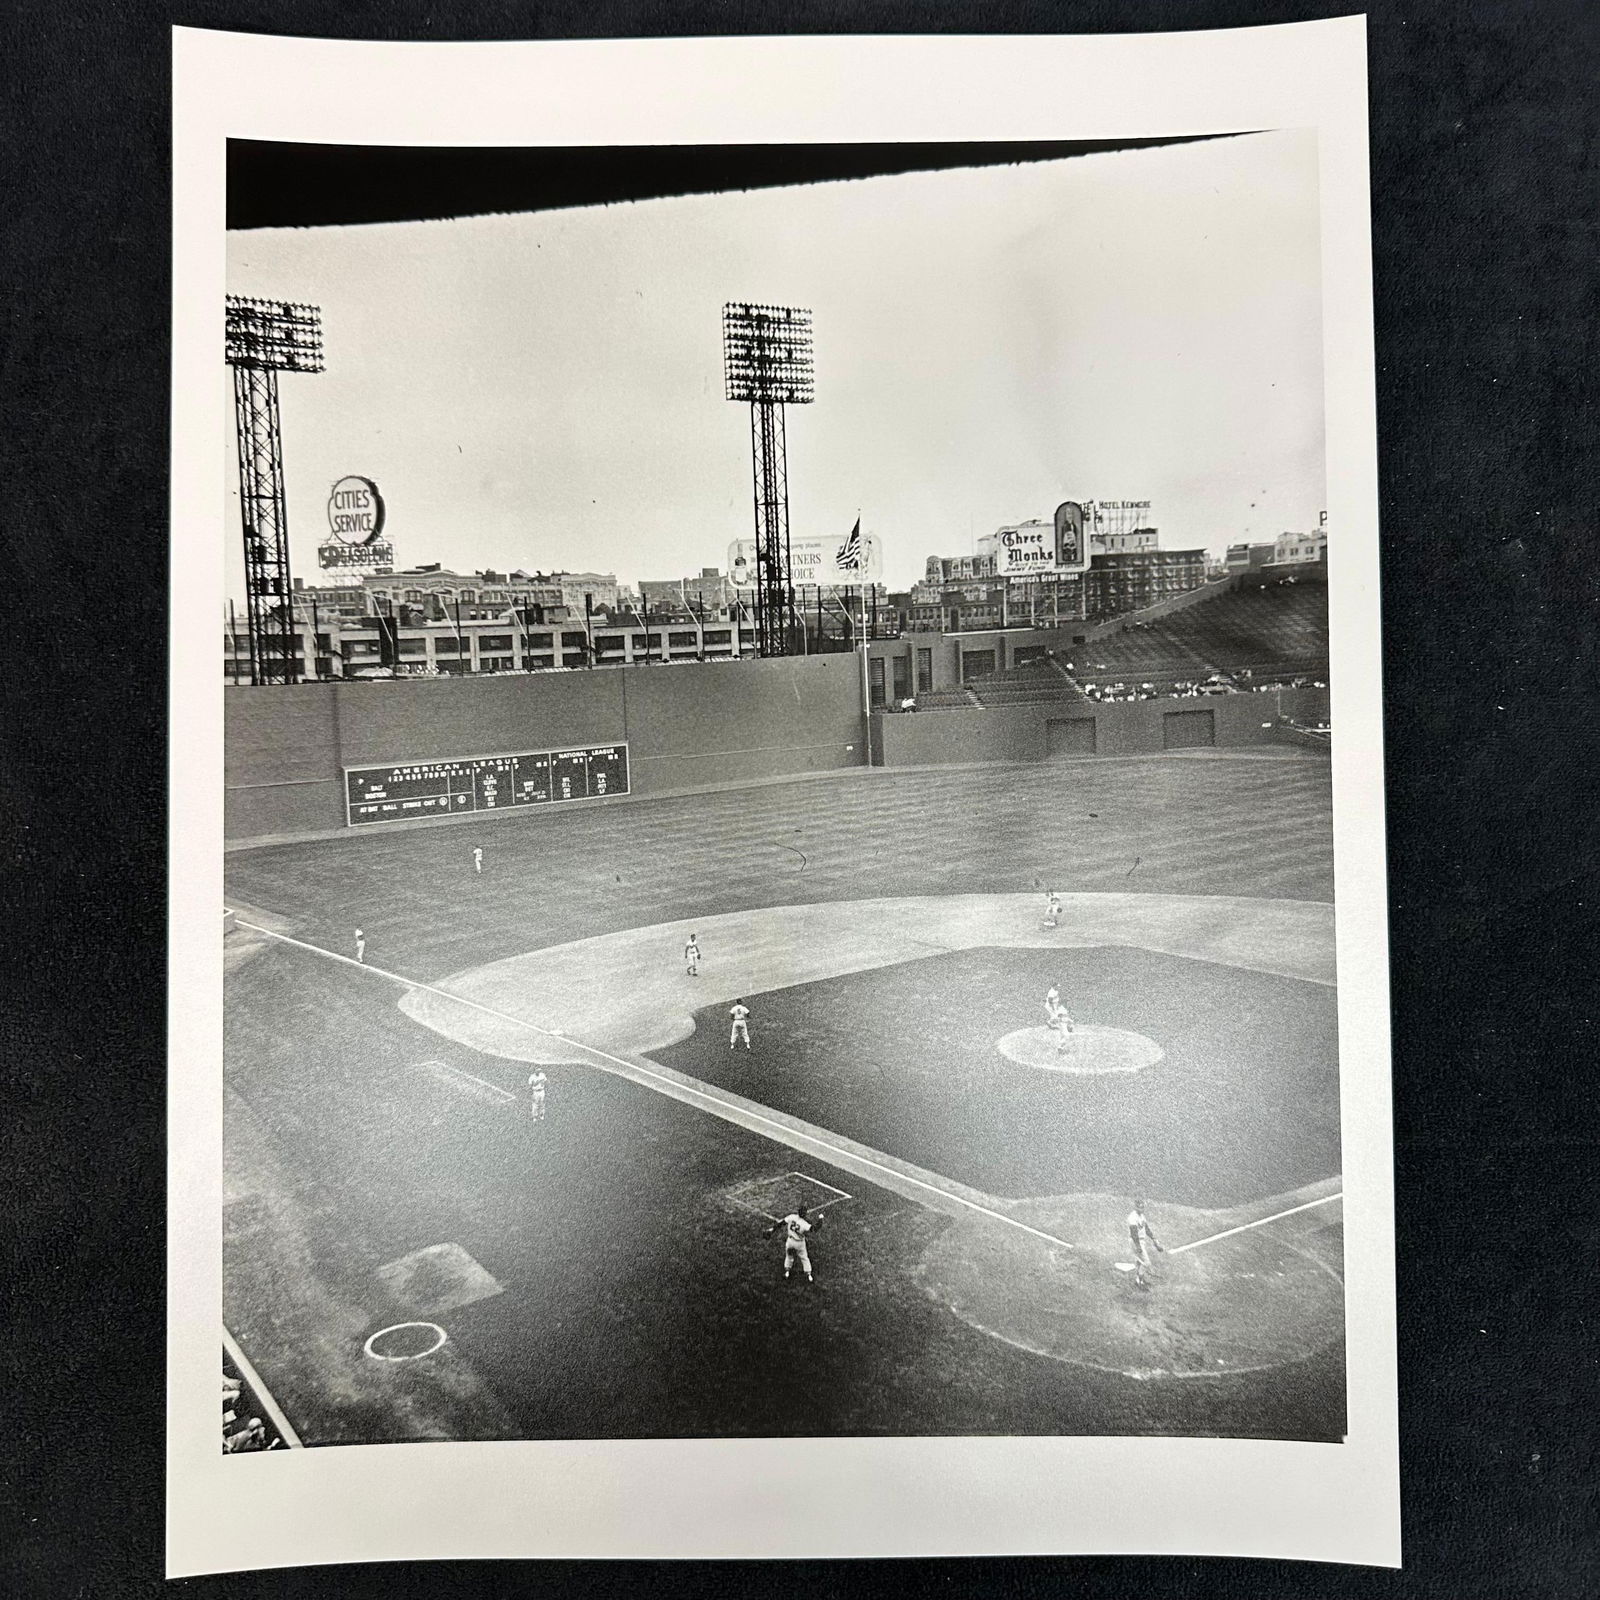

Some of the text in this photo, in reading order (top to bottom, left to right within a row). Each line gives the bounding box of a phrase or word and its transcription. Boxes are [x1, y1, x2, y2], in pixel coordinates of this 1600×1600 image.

[334, 489, 370, 510] CITIES
[334, 513, 373, 533] SERVICE
[1001, 530, 1043, 547] Three
[1007, 547, 1054, 566] Monks
[558, 748, 615, 759] NATIONAL LEAGUE
[393, 758, 518, 775] AMERICAN LEAGUE
